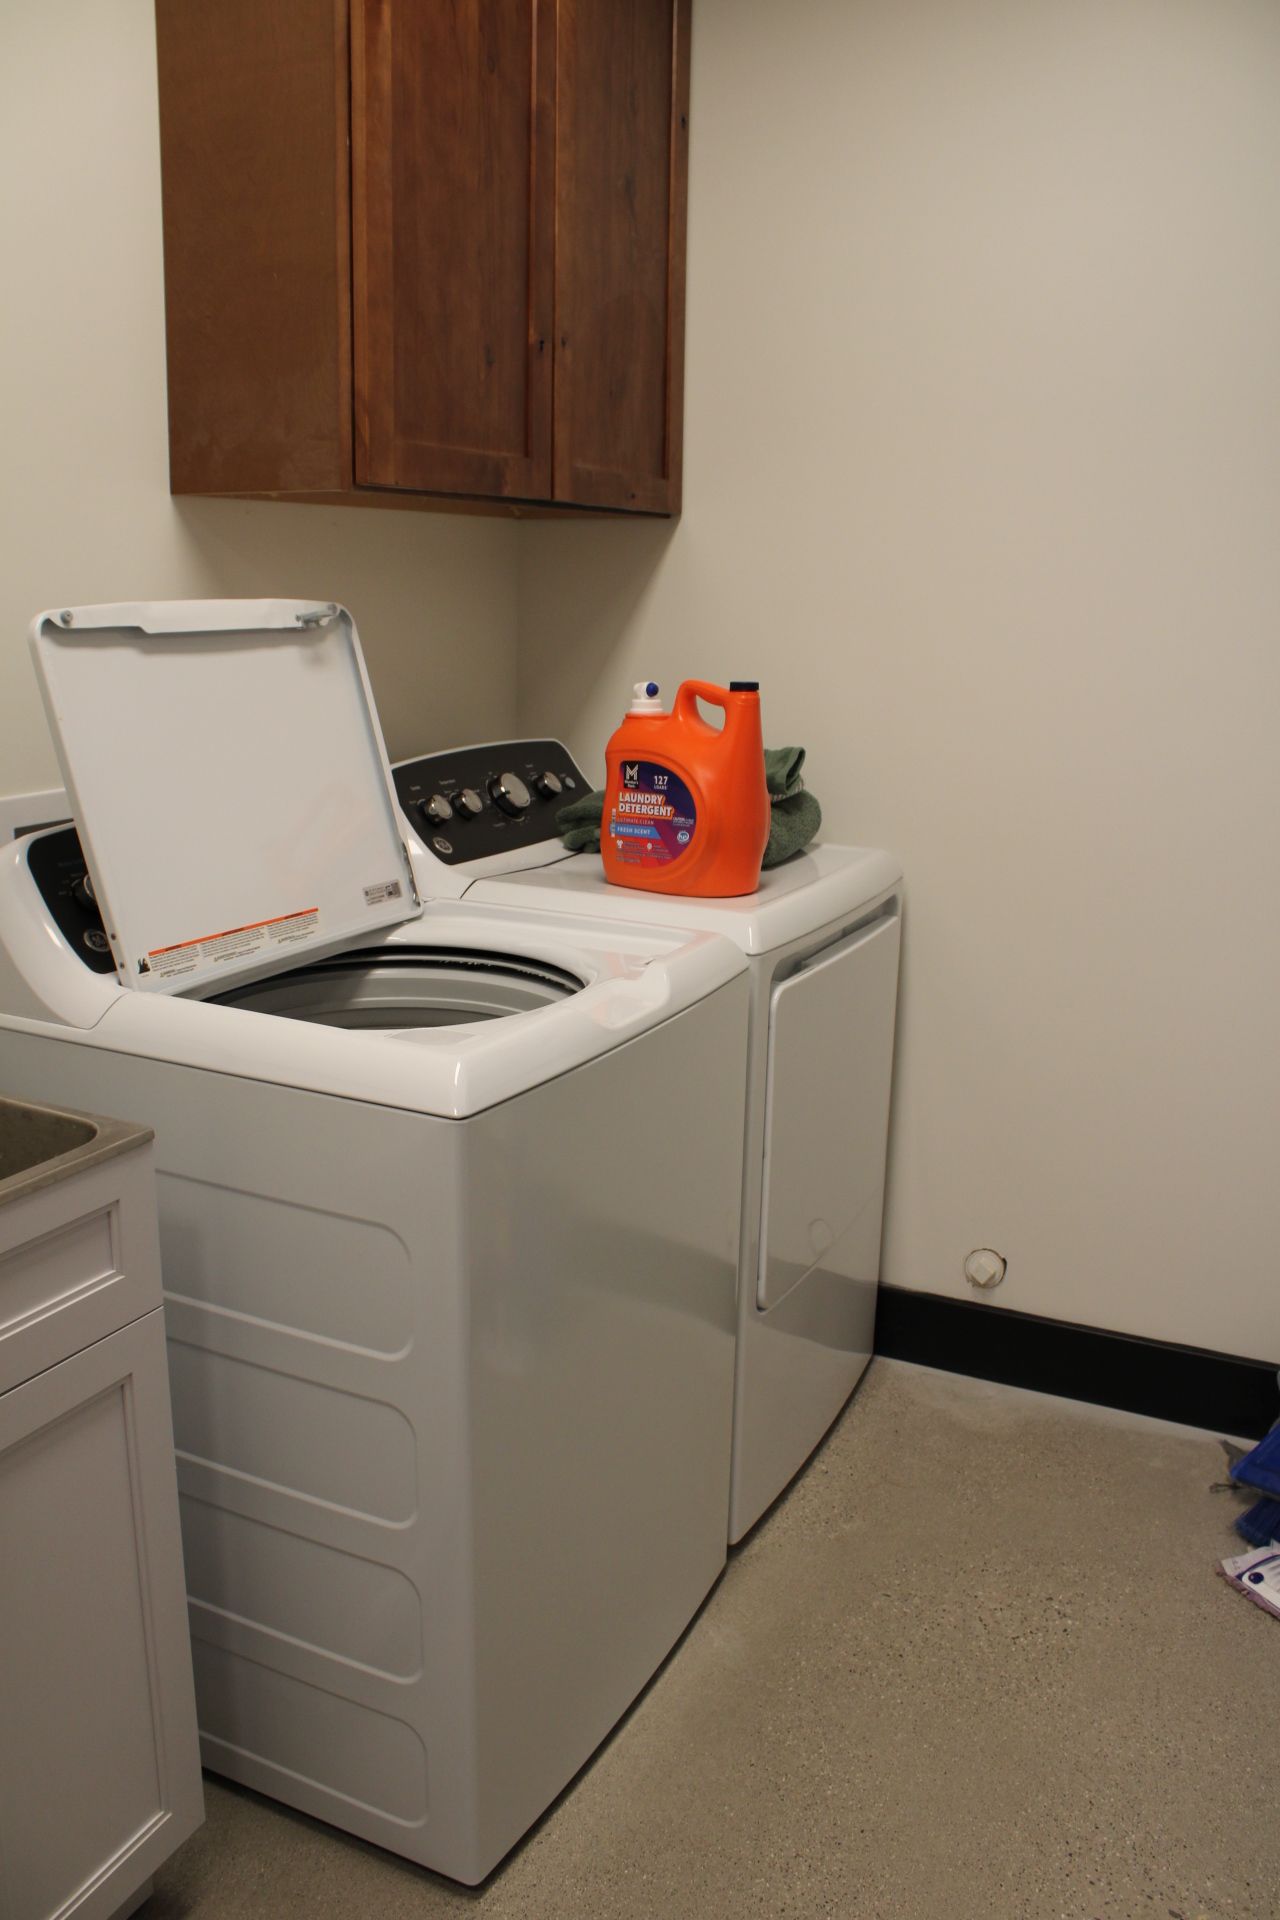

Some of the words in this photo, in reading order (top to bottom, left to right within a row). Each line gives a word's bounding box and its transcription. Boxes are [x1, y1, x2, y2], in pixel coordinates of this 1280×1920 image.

[626, 764, 639, 780] M
[654, 775, 669, 785] 127
[619, 792, 663, 805] LAUNDRY
[618, 803, 672, 816] DETERGENT
